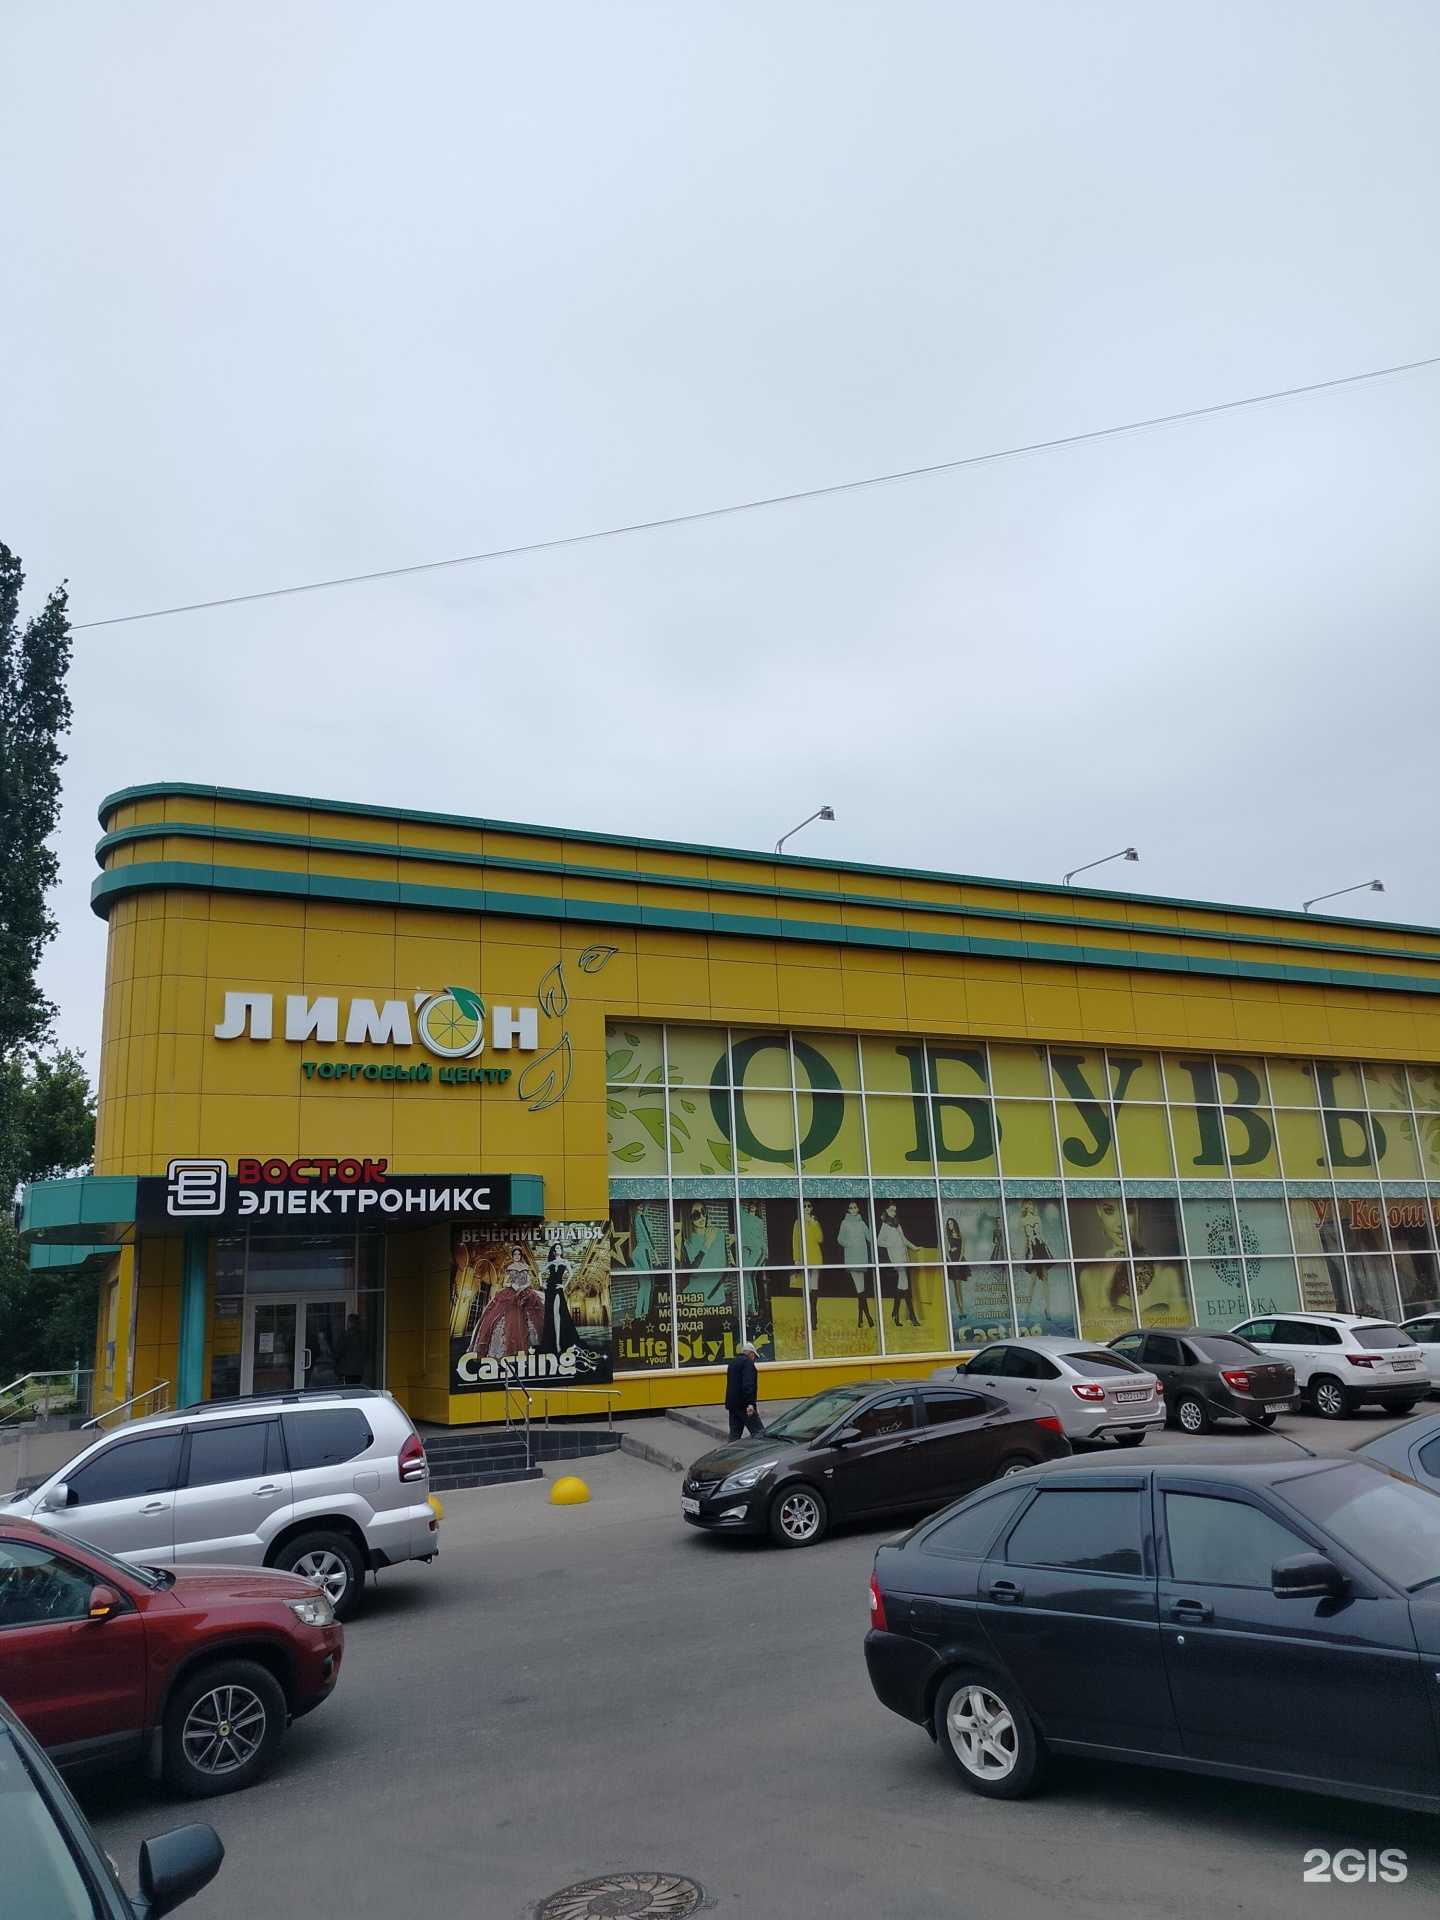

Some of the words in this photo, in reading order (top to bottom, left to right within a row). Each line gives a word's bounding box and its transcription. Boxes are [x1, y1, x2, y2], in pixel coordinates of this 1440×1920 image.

[214, 988, 538, 1058] ЛИМОН
[302, 1062, 432, 1081] ТОРГОВЫЙ
[439, 1067, 512, 1084] ЦЕНТР
[709, 1036, 1388, 1168] ОБУВЬ
[237, 1159, 387, 1185] ВОСТОК
[238, 1187, 491, 1215] ЭЛЕКТРОНИКС
[461, 1227, 541, 1242] ВЕЧЕРНИЕ
[545, 1226, 604, 1241] ПЛАТЬЯ
[626, 1337, 668, 1358] Life
[456, 1346, 577, 1382] Casting
